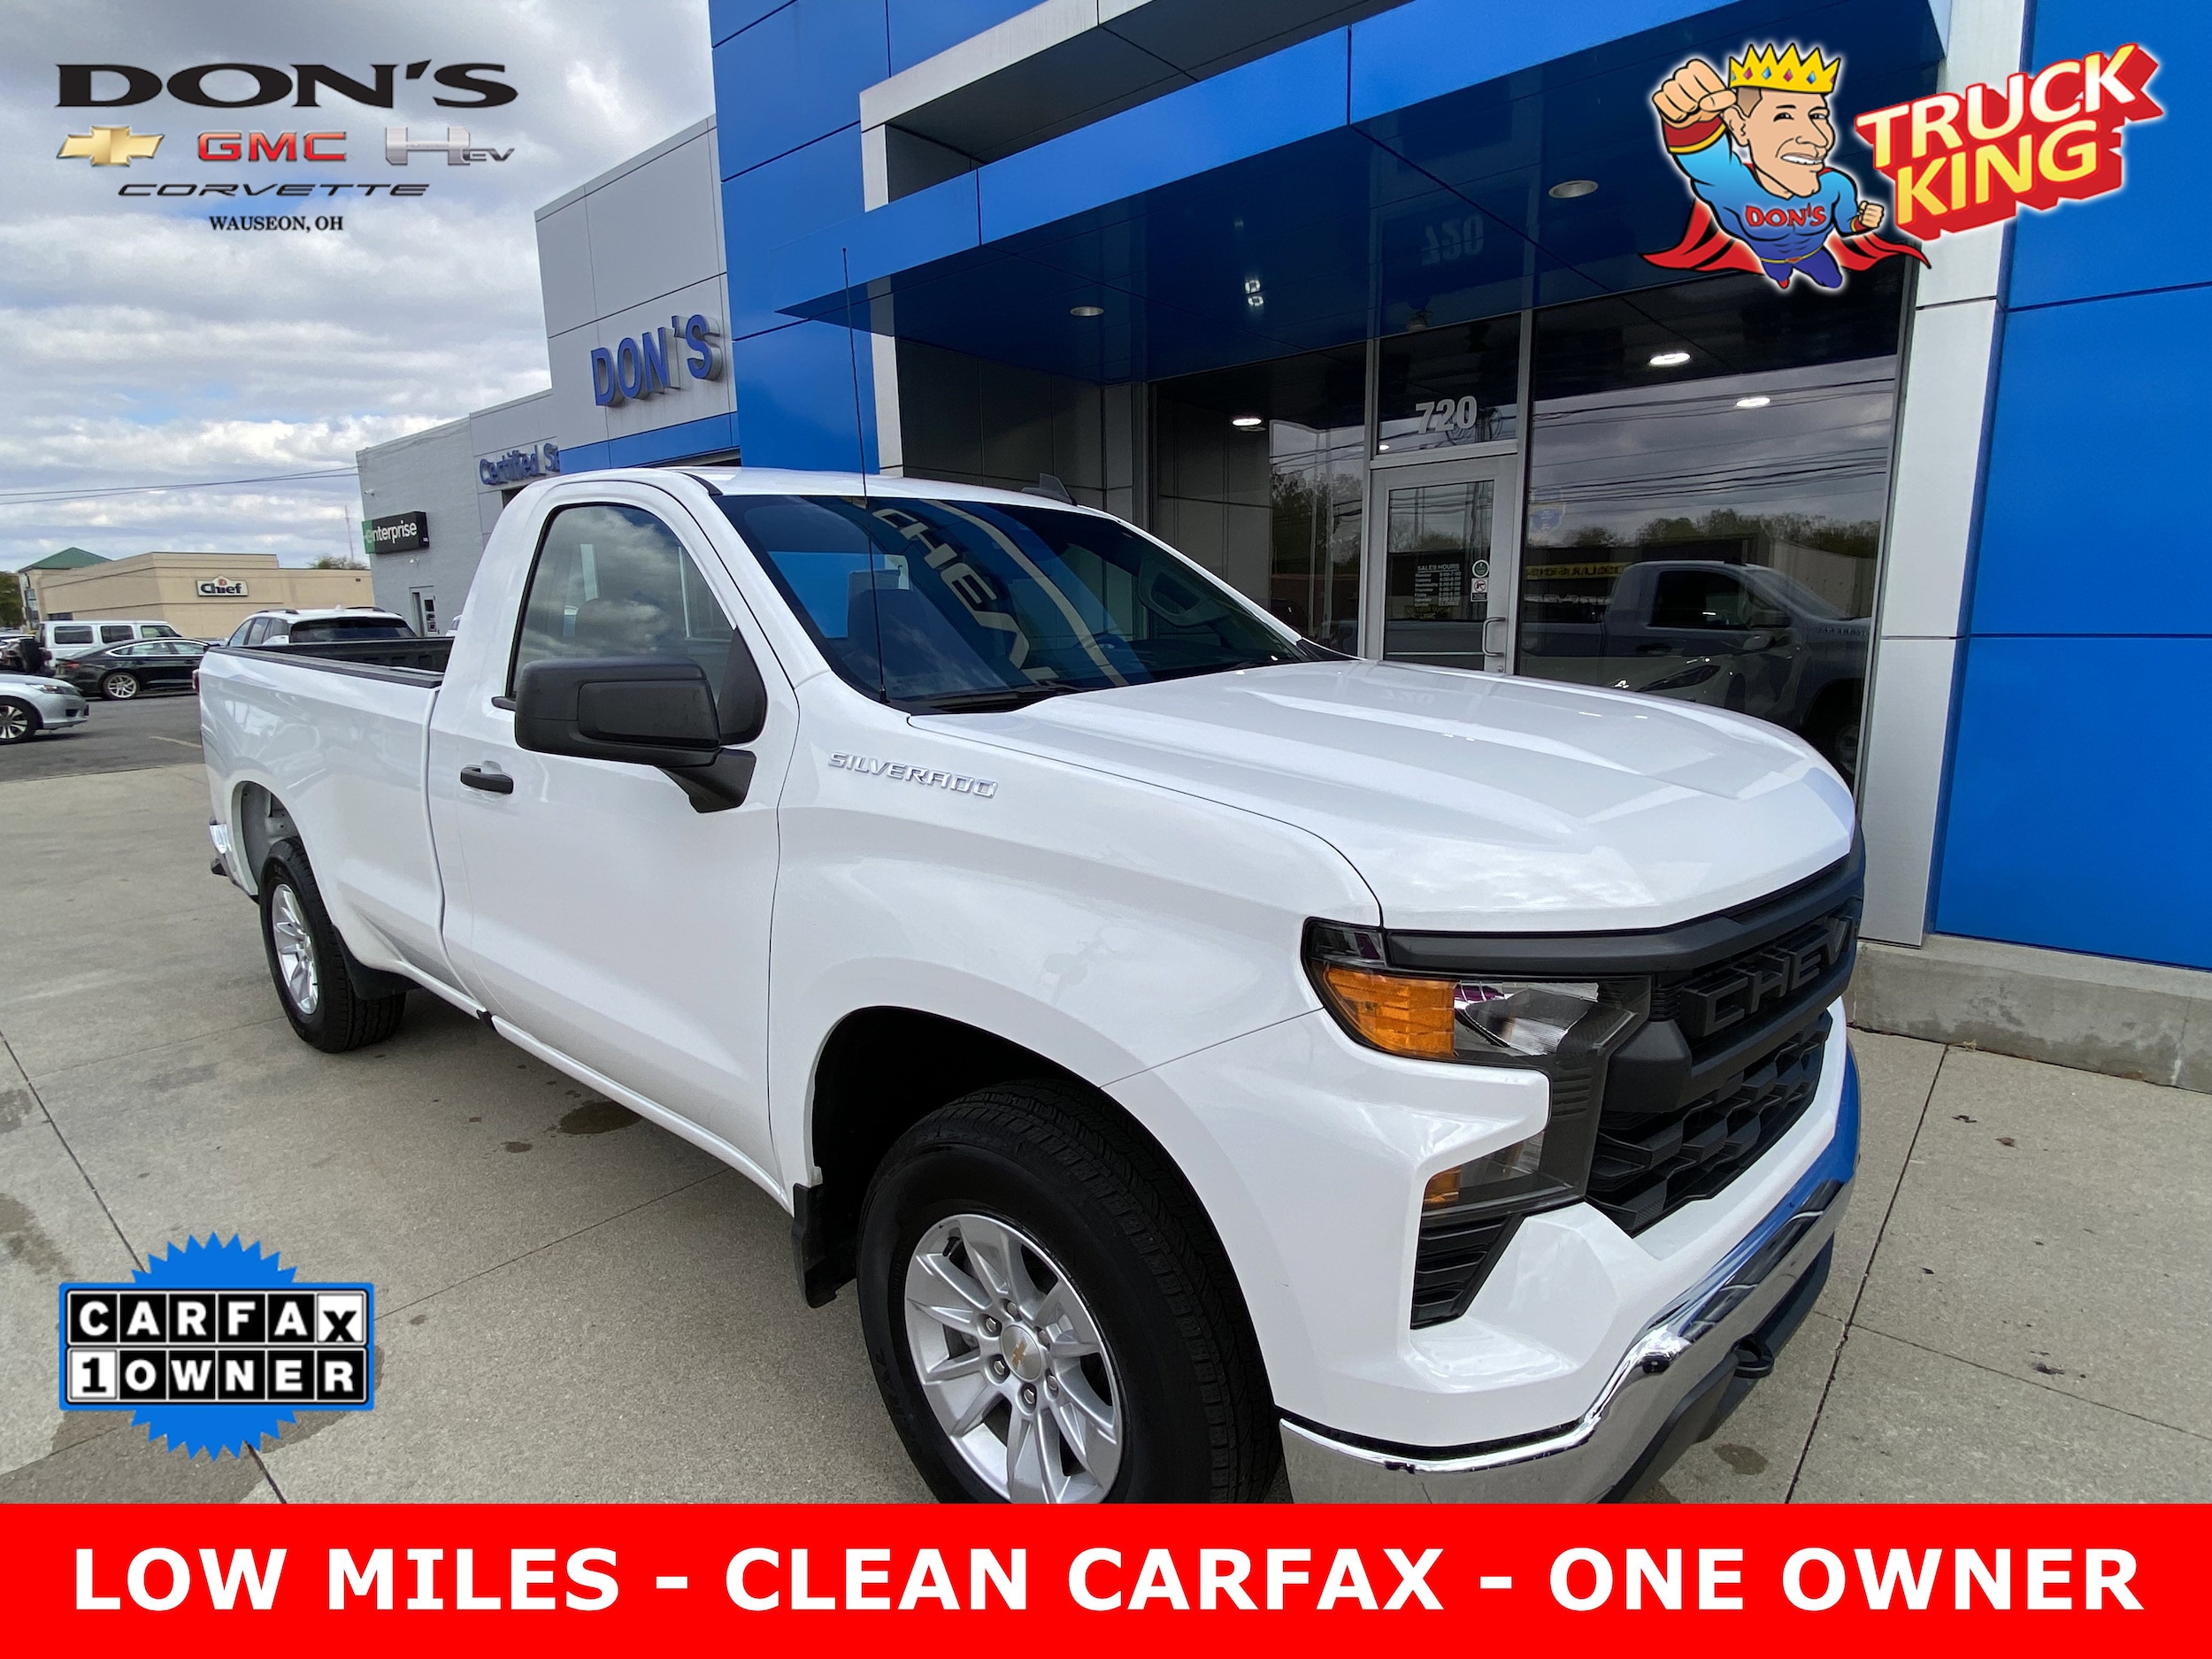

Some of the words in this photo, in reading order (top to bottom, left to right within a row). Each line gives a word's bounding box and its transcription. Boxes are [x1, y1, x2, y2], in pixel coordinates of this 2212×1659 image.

[590, 314, 717, 407] DON'S
[1416, 396, 1478, 434] 720
[480, 444, 540, 486] Certified
[364, 519, 418, 544] enterprise
[200, 582, 242, 595] Chief
[828, 752, 999, 798] SILVERADO
